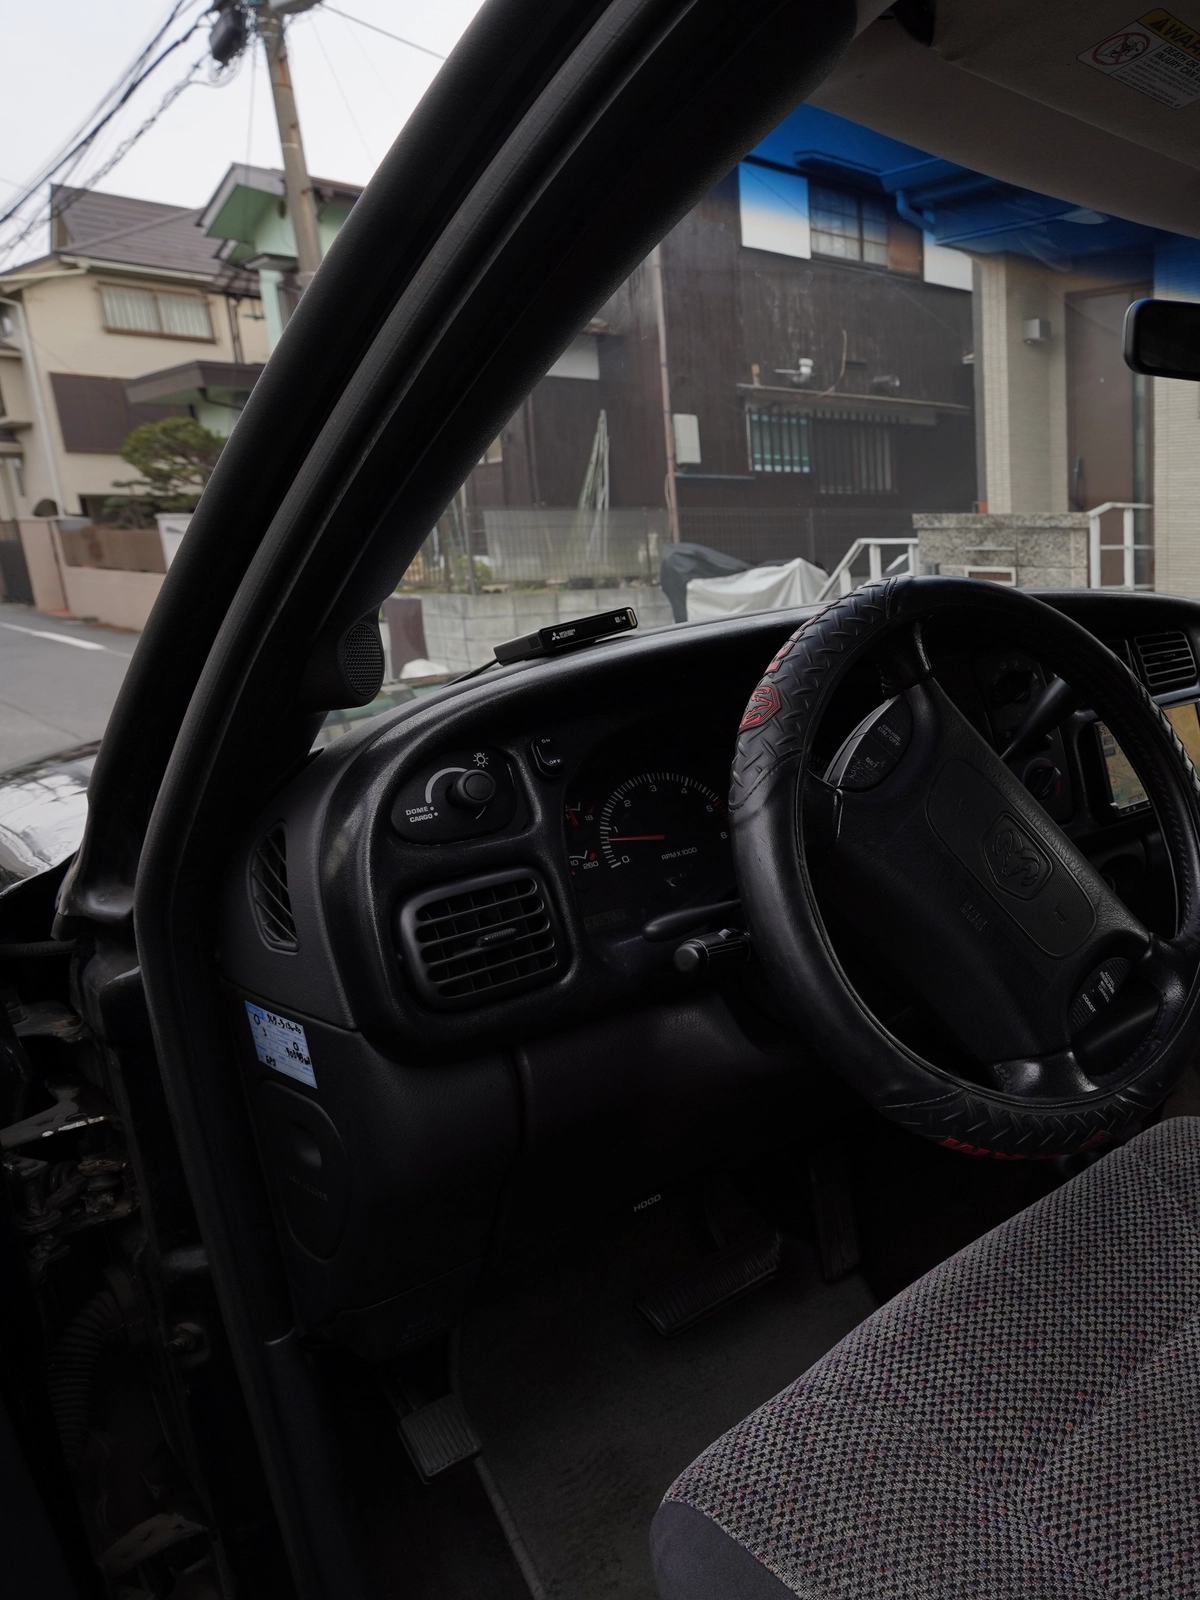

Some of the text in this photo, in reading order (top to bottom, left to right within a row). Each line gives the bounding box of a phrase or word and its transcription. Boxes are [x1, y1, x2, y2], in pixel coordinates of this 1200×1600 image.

[1163, 46, 1187, 63] DEATH
[1187, 59, 1199, 69] OR
[1154, 52, 1182, 72] INJURY
[1180, 67, 1197, 79] CAN
[877, 726, 901, 746] ON/OFF
[882, 724, 901, 741] CRUISE
[865, 756, 879, 768] SET
[649, 784, 657, 793] 3
[681, 787, 688, 795] 4
[623, 799, 632, 808] 2
[706, 804, 714, 813] 5
[405, 806, 429, 816] DOME
[410, 813, 433, 823] CARGO
[584, 814, 594, 822] 18
[720, 831, 728, 839] 6
[621, 854, 630, 864] 0
[583, 860, 599, 870] 260
[1082, 993, 1096, 1012] COAST
[633, 1193, 661, 1213] HOOD
